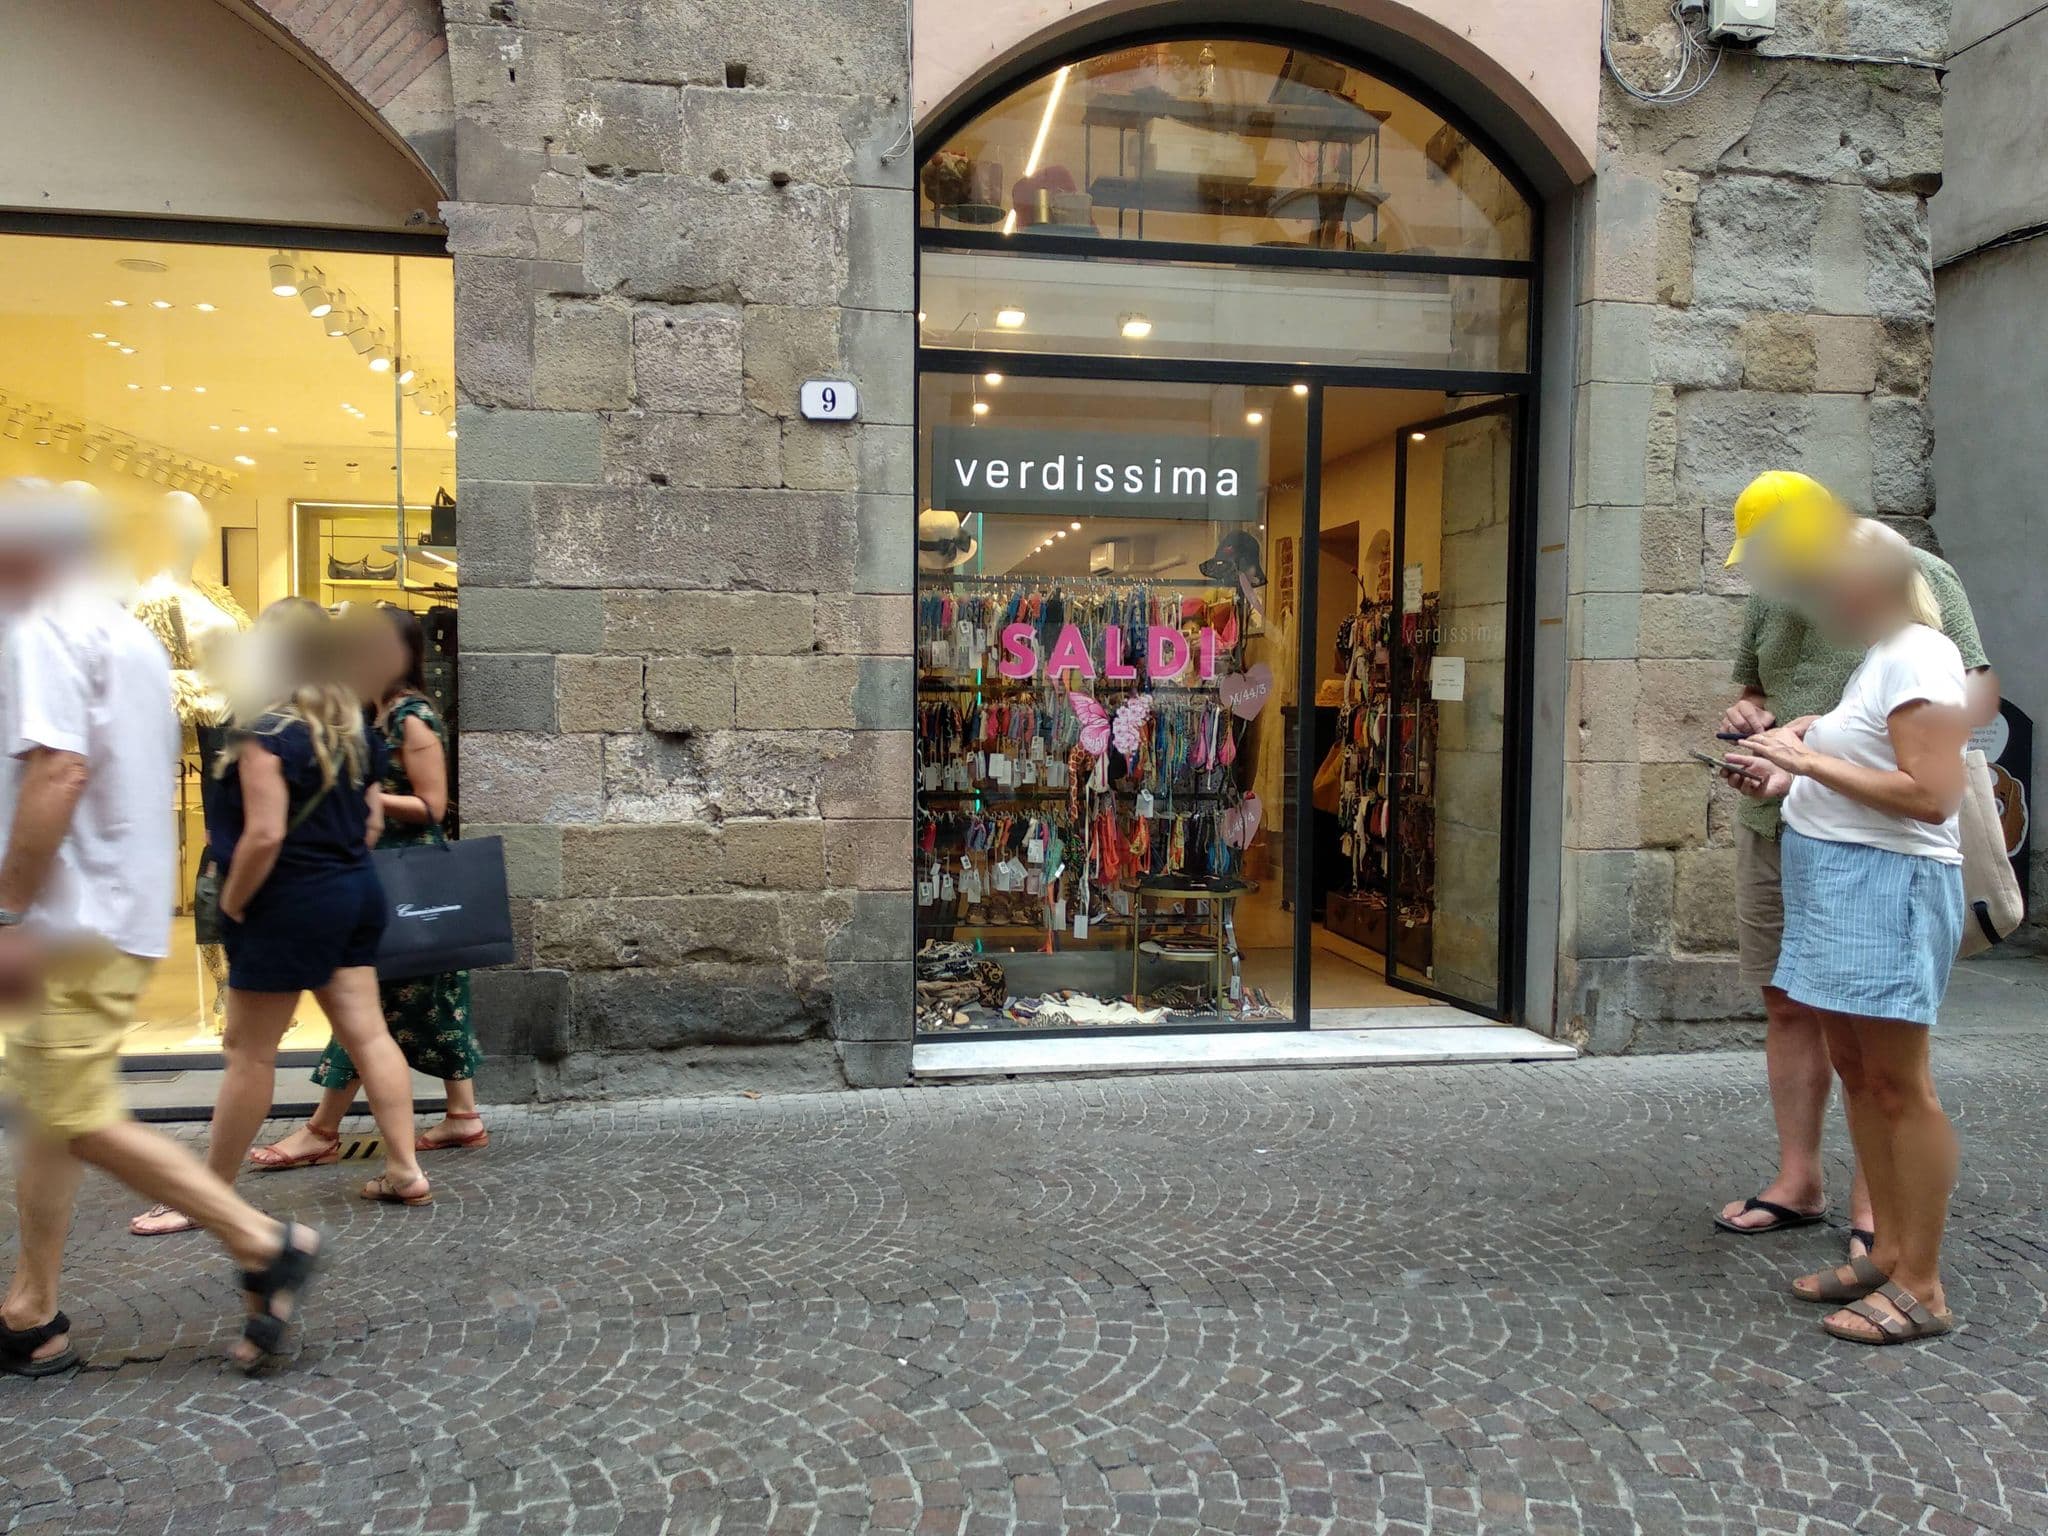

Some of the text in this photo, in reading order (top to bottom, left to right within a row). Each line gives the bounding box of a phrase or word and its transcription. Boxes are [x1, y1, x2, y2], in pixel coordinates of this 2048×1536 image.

[822, 387, 836, 413] 9
[954, 455, 1239, 497] verdissima
[1405, 621, 1503, 644] verdissima
[999, 622, 1216, 681] SALDI
